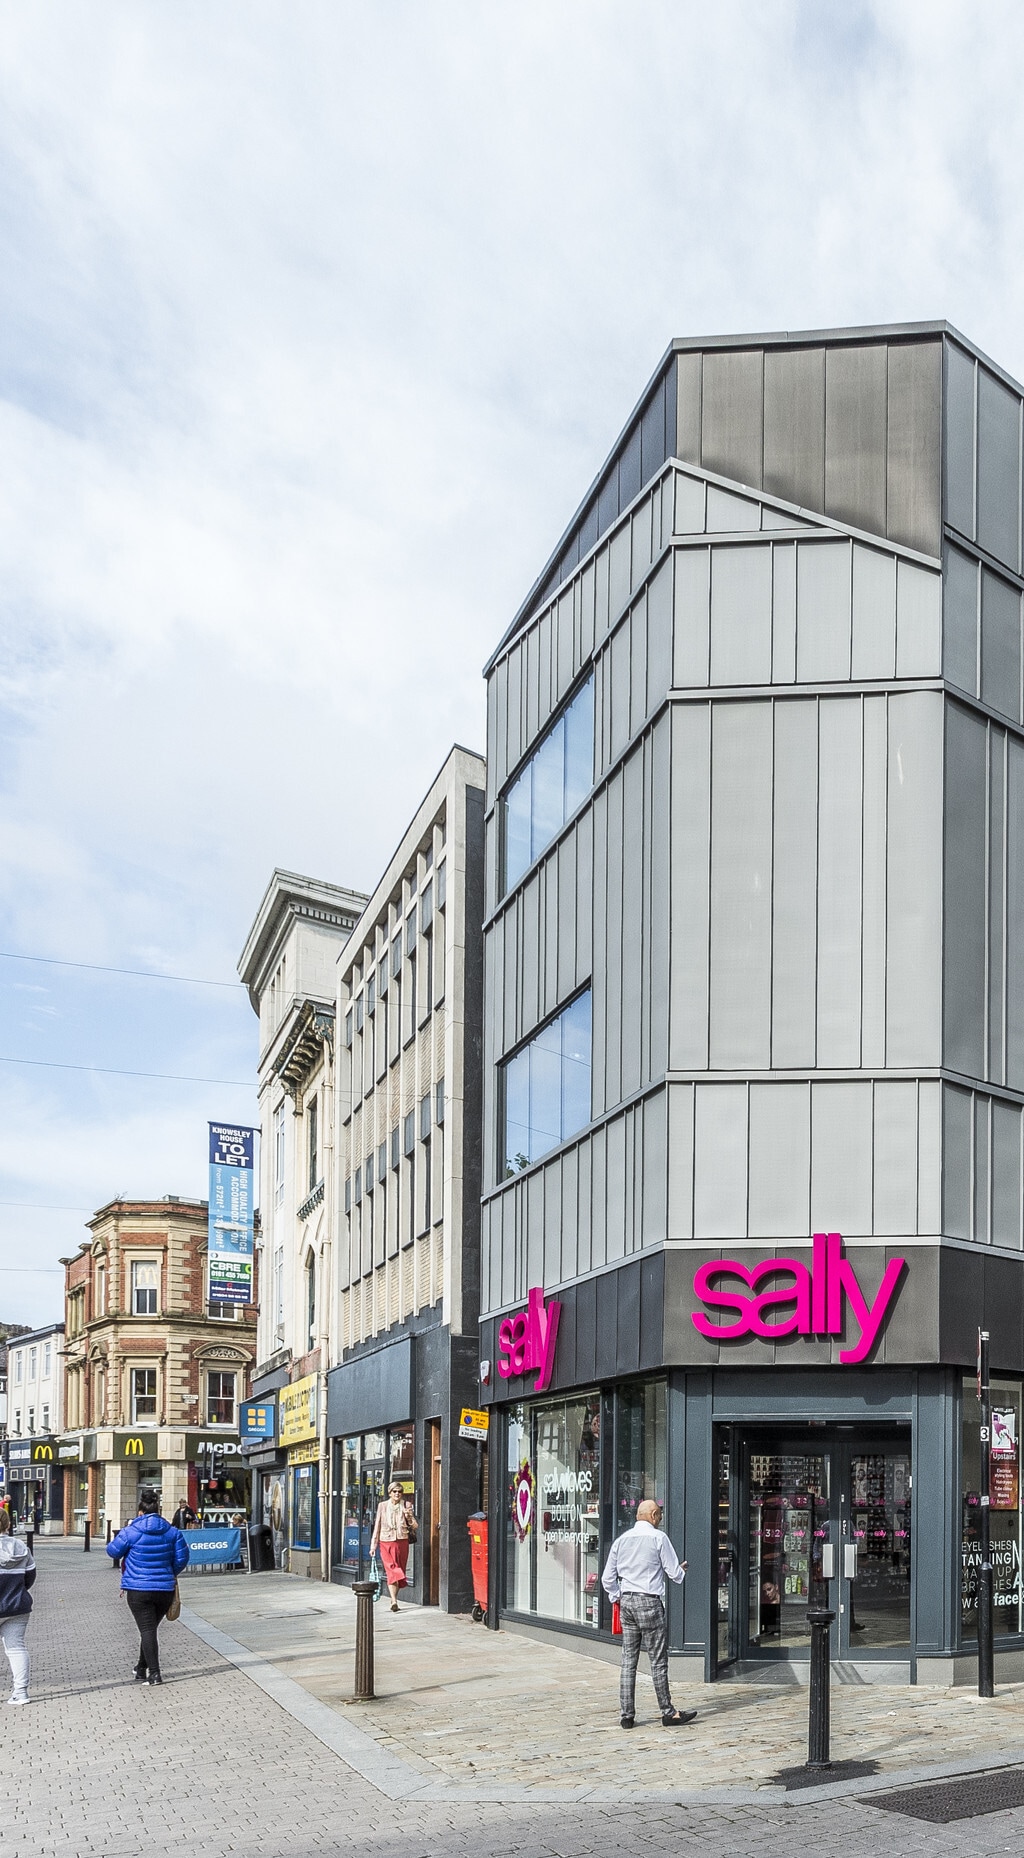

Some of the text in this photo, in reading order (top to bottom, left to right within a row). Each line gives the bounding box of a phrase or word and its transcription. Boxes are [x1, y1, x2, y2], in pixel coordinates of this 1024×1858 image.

[212, 1126, 251, 1138] KNOWSLEY
[220, 1135, 243, 1144] HOUSE
[218, 1142, 245, 1155] TO
[215, 1152, 249, 1167] LET
[240, 1170, 248, 1190] HIGH
[231, 1176, 239, 1244] ACCOMMODAON
[240, 1192, 248, 1223] QUALITY
[210, 1262, 241, 1272] CBRE
[691, 1233, 905, 1364] sally
[497, 1287, 562, 1392] sally
[993, 1452, 1016, 1461] Upstairs
[551, 1504, 582, 1522] BOLTON
[190, 1541, 228, 1550] GREGGS
[962, 1540, 1012, 1552] EYELSHES
[962, 1552, 1012, 1567] TANING
[997, 1566, 1012, 1577] UP
[962, 1578, 1012, 1592] BRHES
[993, 1592, 1019, 1606] face
